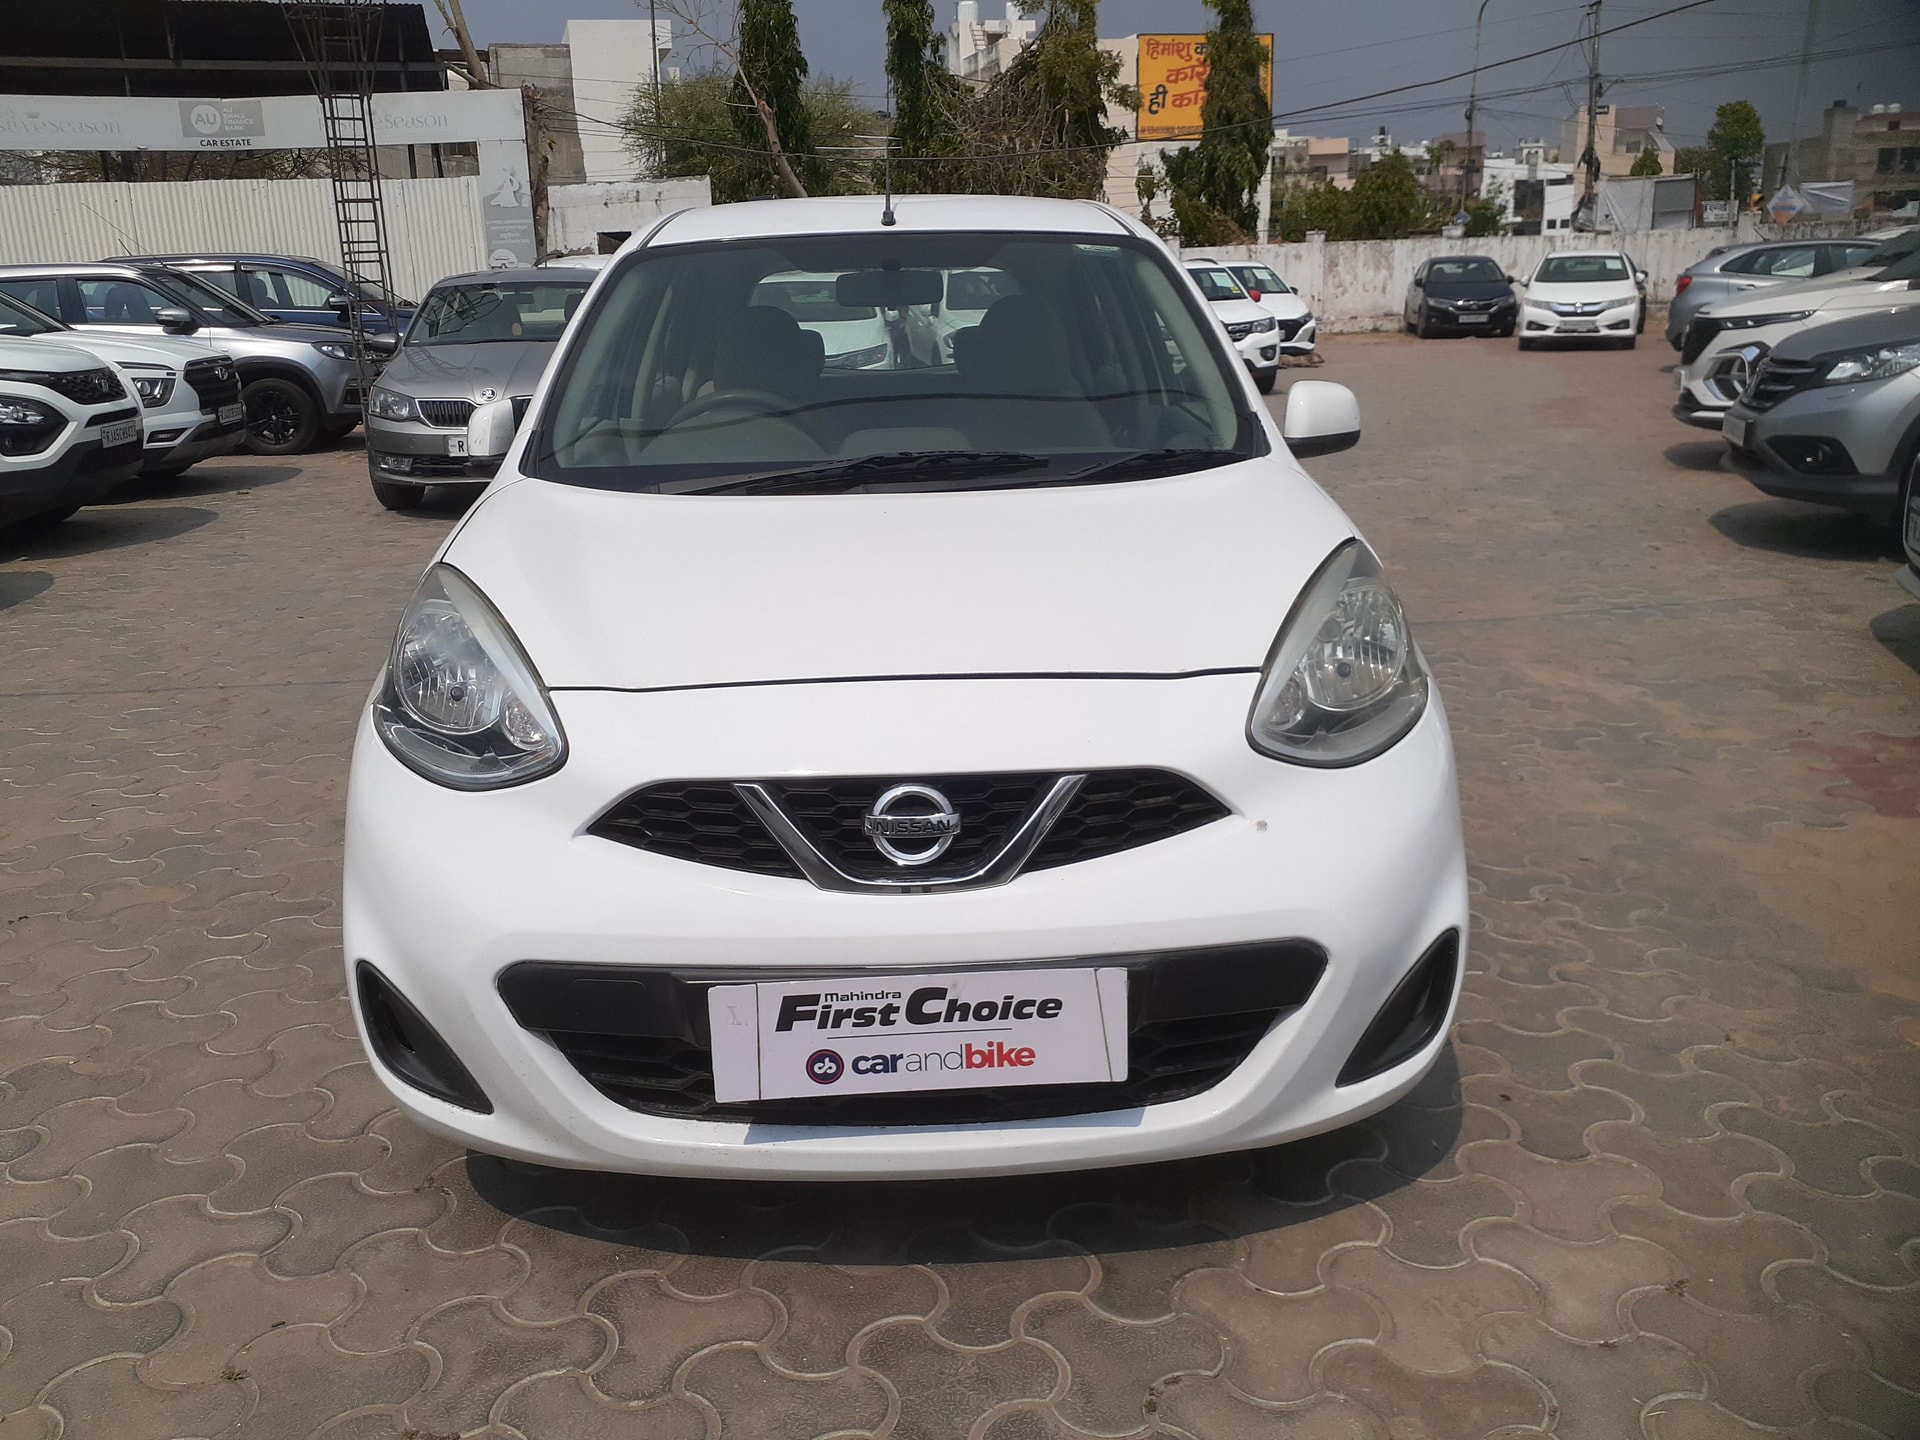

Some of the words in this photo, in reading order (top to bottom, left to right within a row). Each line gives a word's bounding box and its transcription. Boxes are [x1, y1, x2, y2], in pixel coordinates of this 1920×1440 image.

[1148, 84, 1168, 115] ही
[195, 112, 218, 125] AU
[200, 139, 218, 147] CAR
[220, 138, 252, 147] ESTATE
[875, 819, 951, 834] NISSAN
[824, 990, 902, 1003] Mahindra
[775, 993, 901, 1033] First
[905, 986, 1064, 1026] Choice
[851, 1041, 1037, 1075] carandbike
